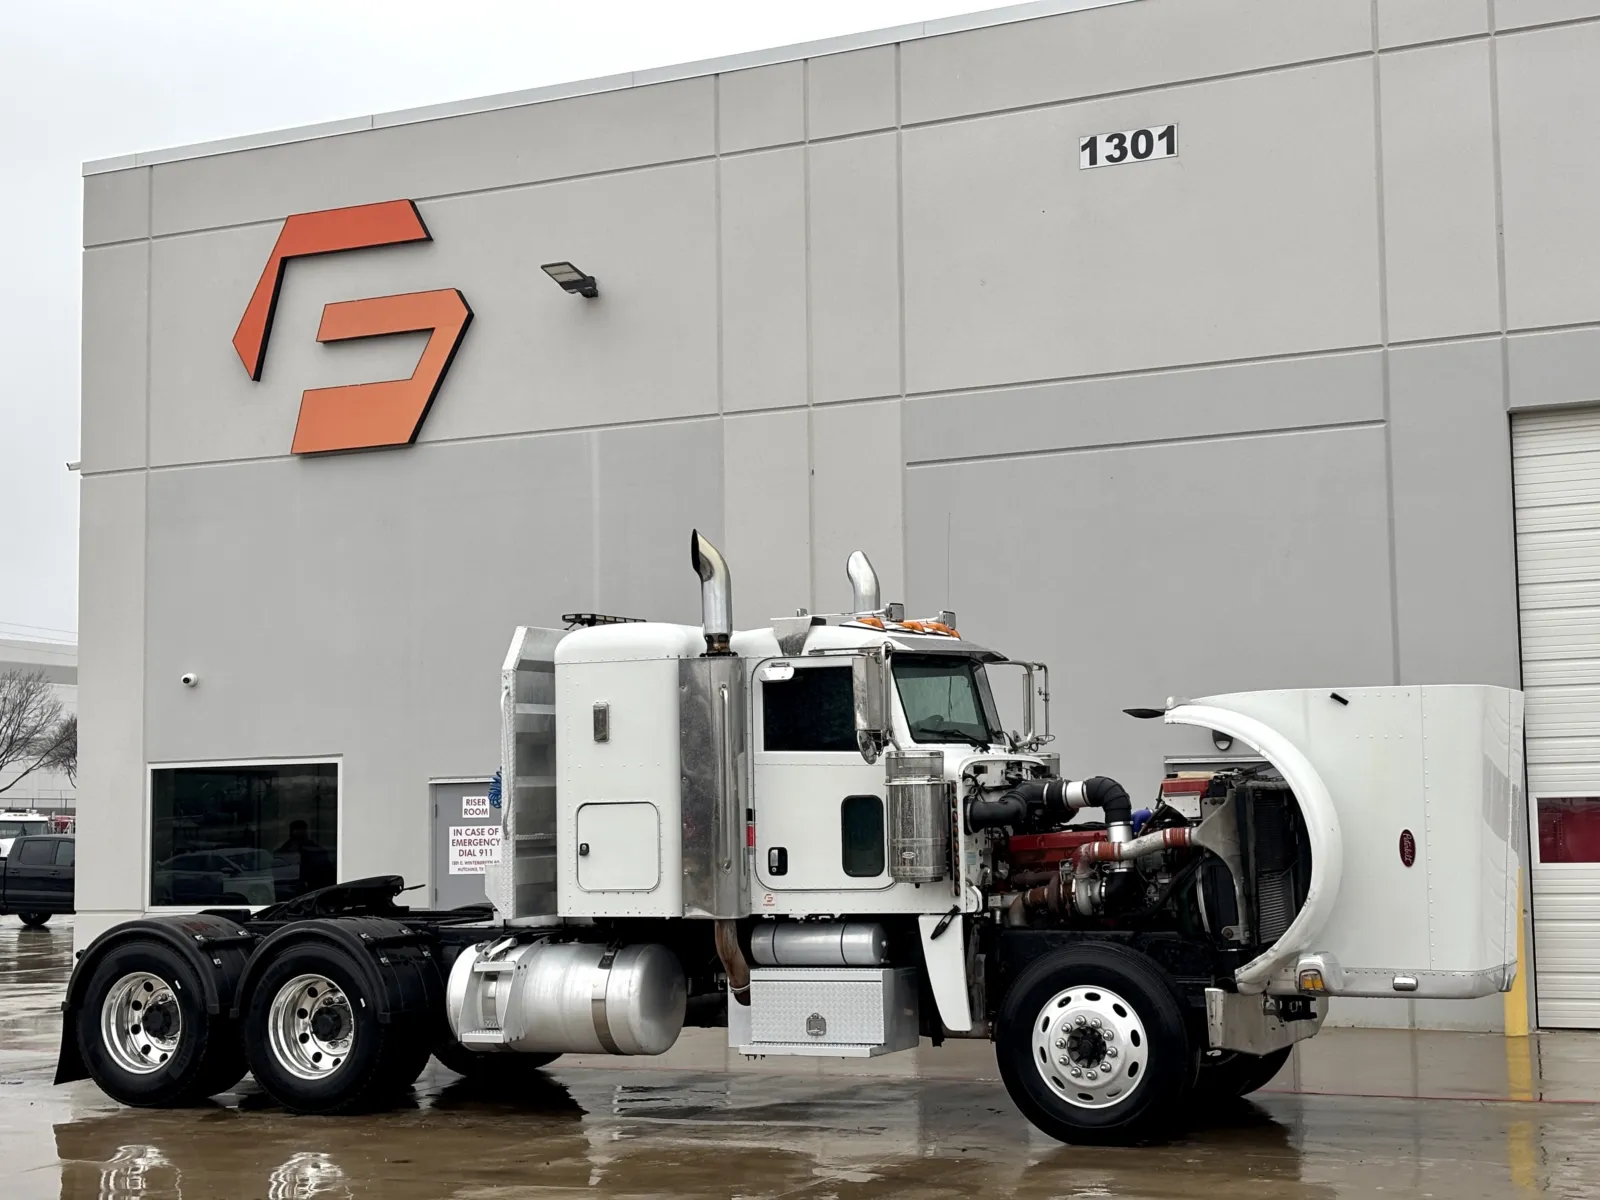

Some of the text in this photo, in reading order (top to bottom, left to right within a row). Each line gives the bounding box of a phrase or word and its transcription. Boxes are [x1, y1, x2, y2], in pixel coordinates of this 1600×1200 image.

[1081, 125, 1175, 166] 1301
[464, 808, 488, 816] ROOM
[465, 828, 485, 836] CASE
[452, 838, 500, 847] EMERGENCY
[458, 849, 477, 857] DIAL
